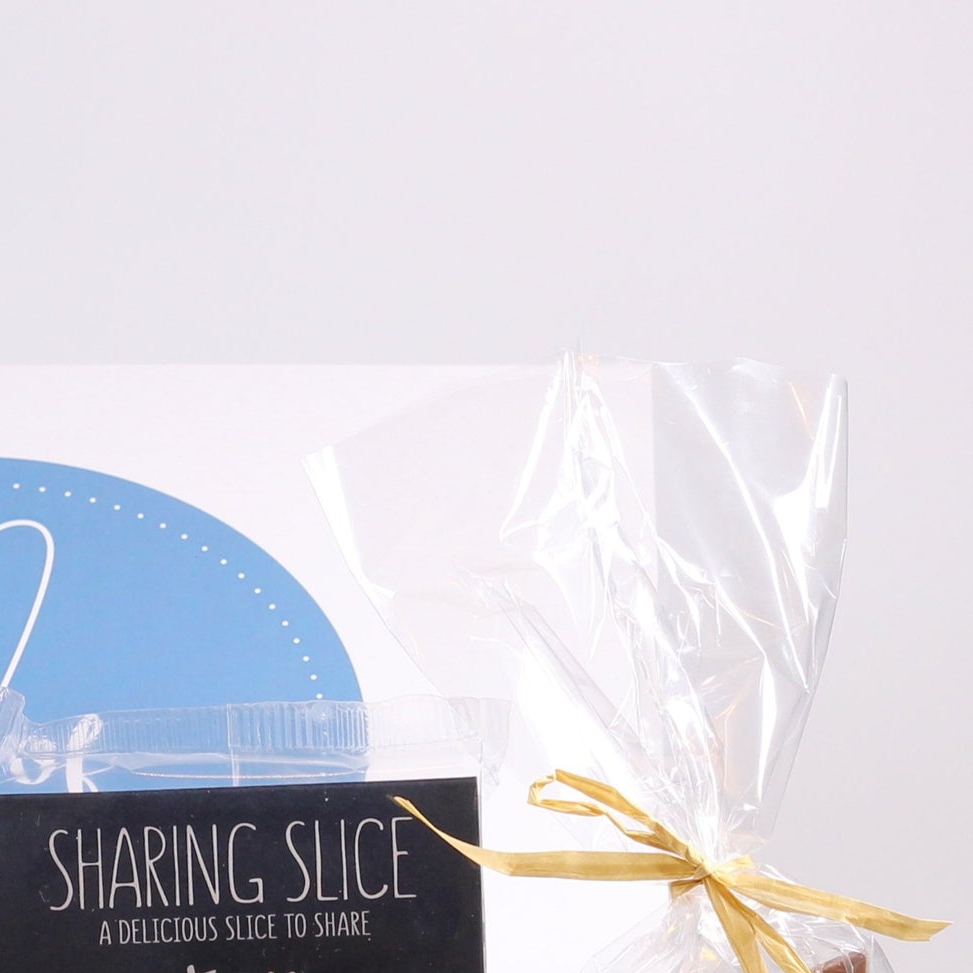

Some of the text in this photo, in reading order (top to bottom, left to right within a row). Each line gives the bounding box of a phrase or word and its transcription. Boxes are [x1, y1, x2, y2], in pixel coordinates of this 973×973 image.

[48, 816, 417, 912] SHARING SLICE
[99, 910, 371, 945] A DELICIOUS SLICE TO SHARE
